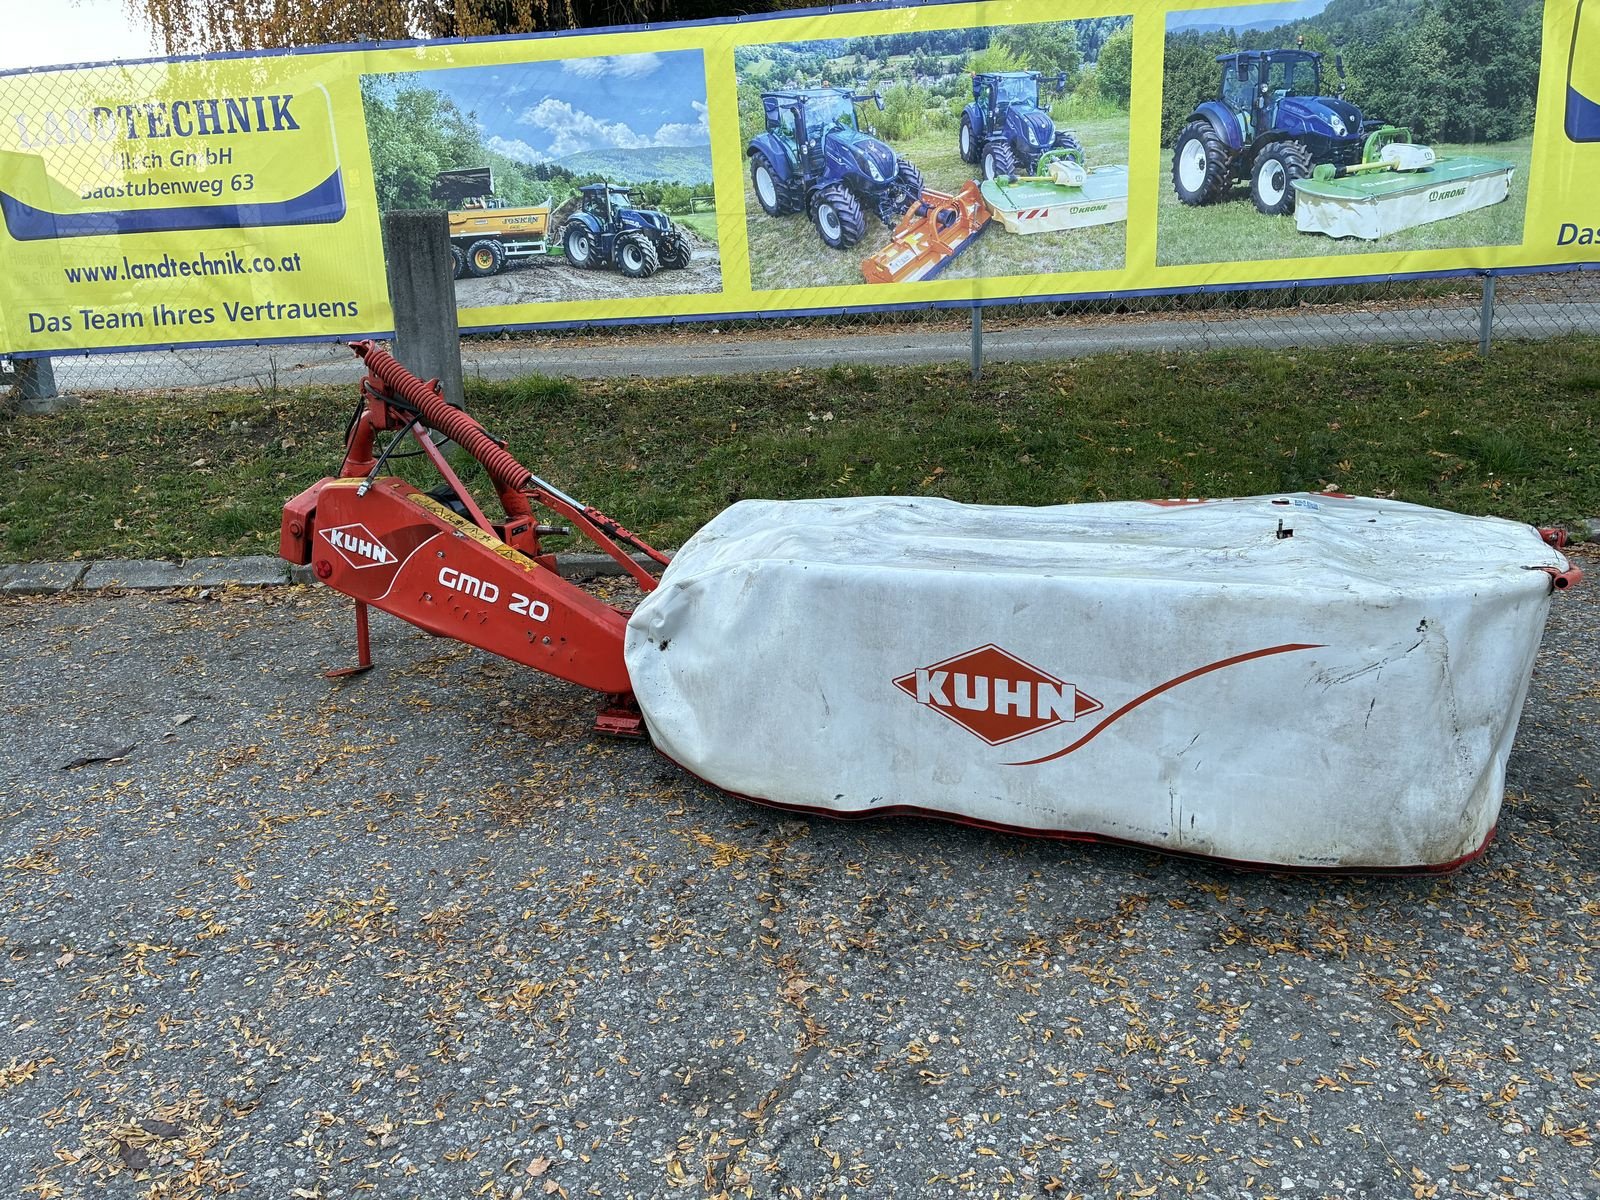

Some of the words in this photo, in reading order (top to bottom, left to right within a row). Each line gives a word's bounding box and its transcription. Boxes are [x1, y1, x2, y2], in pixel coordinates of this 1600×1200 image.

[15, 95, 300, 148] LANDTECHNIK
[101, 150, 162, 171] Villch
[169, 147, 232, 167] GmbH
[230, 174, 254, 191] 63
[1438, 187, 1467, 200] KRONE
[1078, 204, 1109, 213] KRONE
[64, 251, 302, 283] www.landtechnik.co.at
[28, 311, 72, 333] Das
[80, 307, 144, 330] Team
[153, 303, 215, 325] Ihres
[223, 301, 358, 323] Vertrauens
[330, 528, 386, 564] KUHN
[438, 566, 499, 603] GMD
[508, 592, 549, 622] 20
[915, 668, 1076, 722] KUHN
